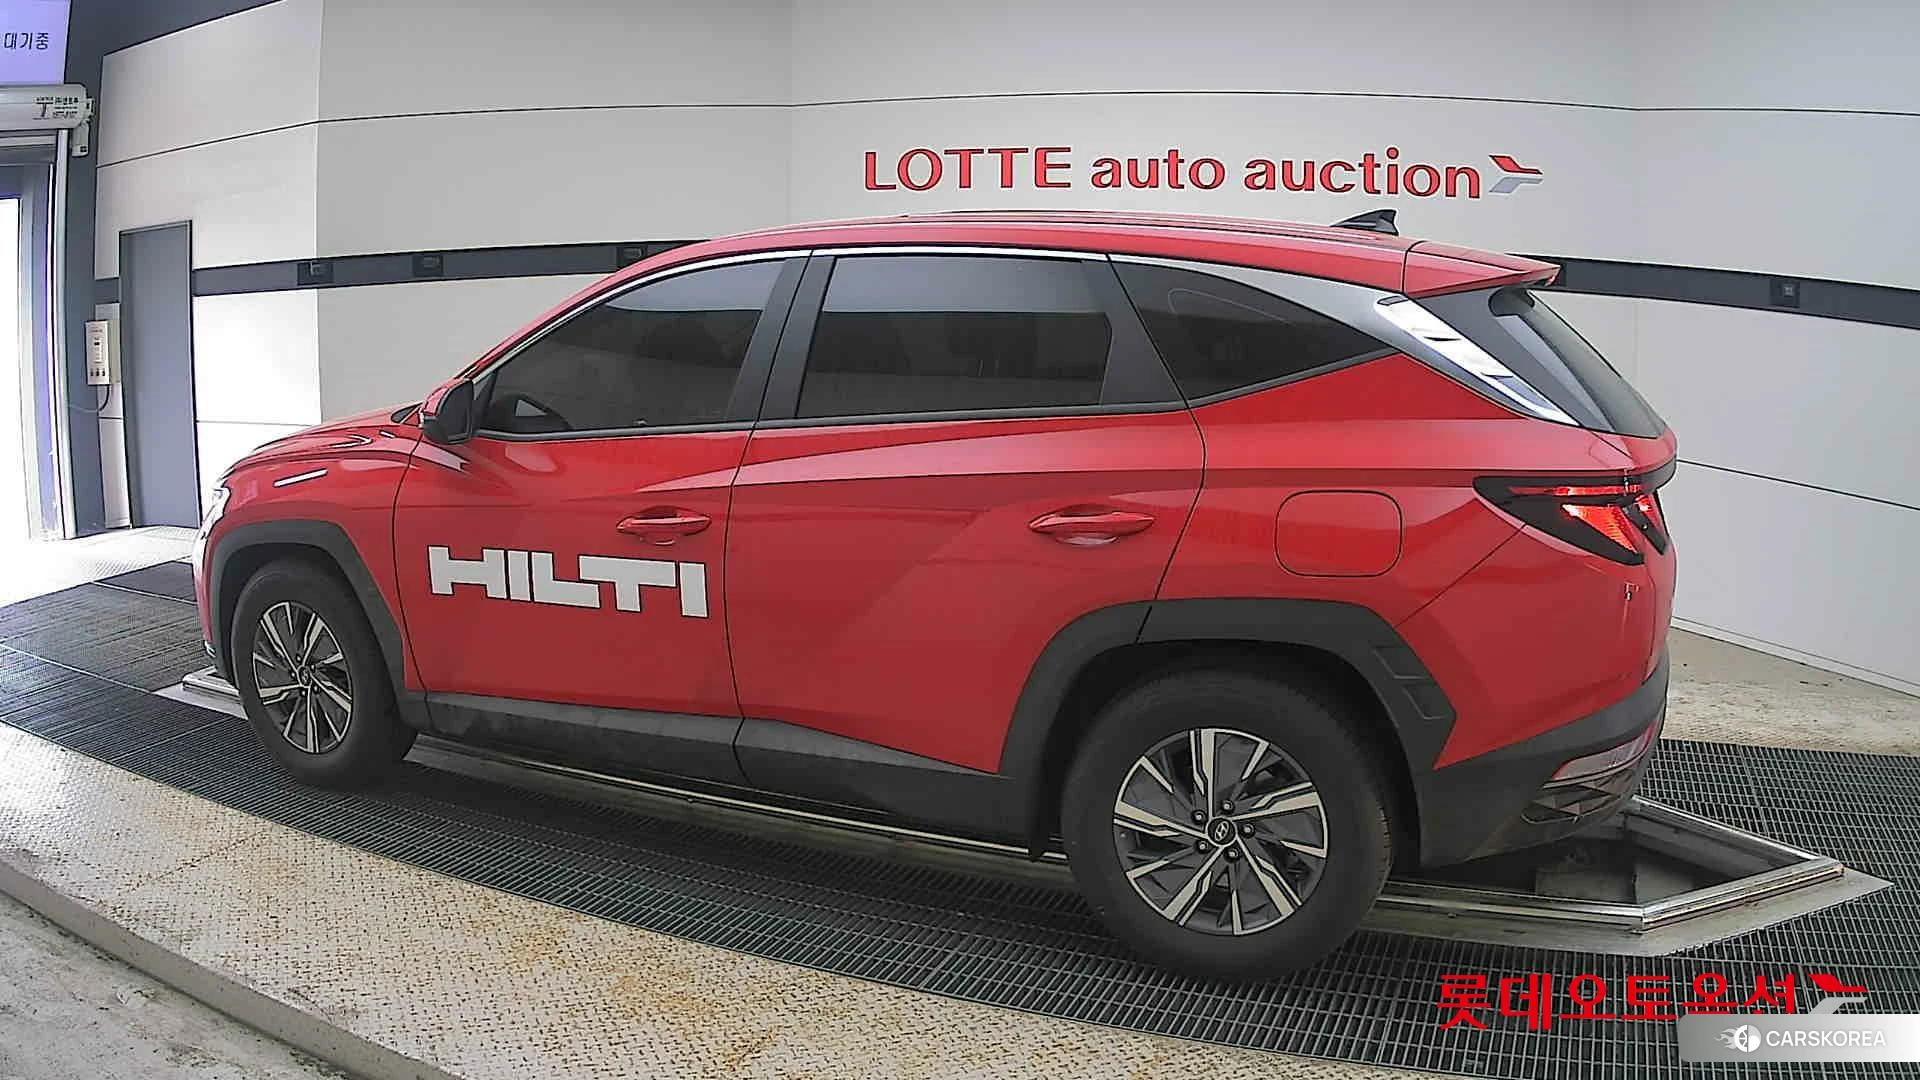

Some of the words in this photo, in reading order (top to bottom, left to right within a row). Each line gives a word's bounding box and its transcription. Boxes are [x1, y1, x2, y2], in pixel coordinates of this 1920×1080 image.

[4, 32, 49, 50] 대기중
[864, 146, 1073, 192] LOTTE
[1091, 149, 1226, 191] auto
[1243, 147, 1481, 199] auction
[428, 546, 708, 618] HILTI
